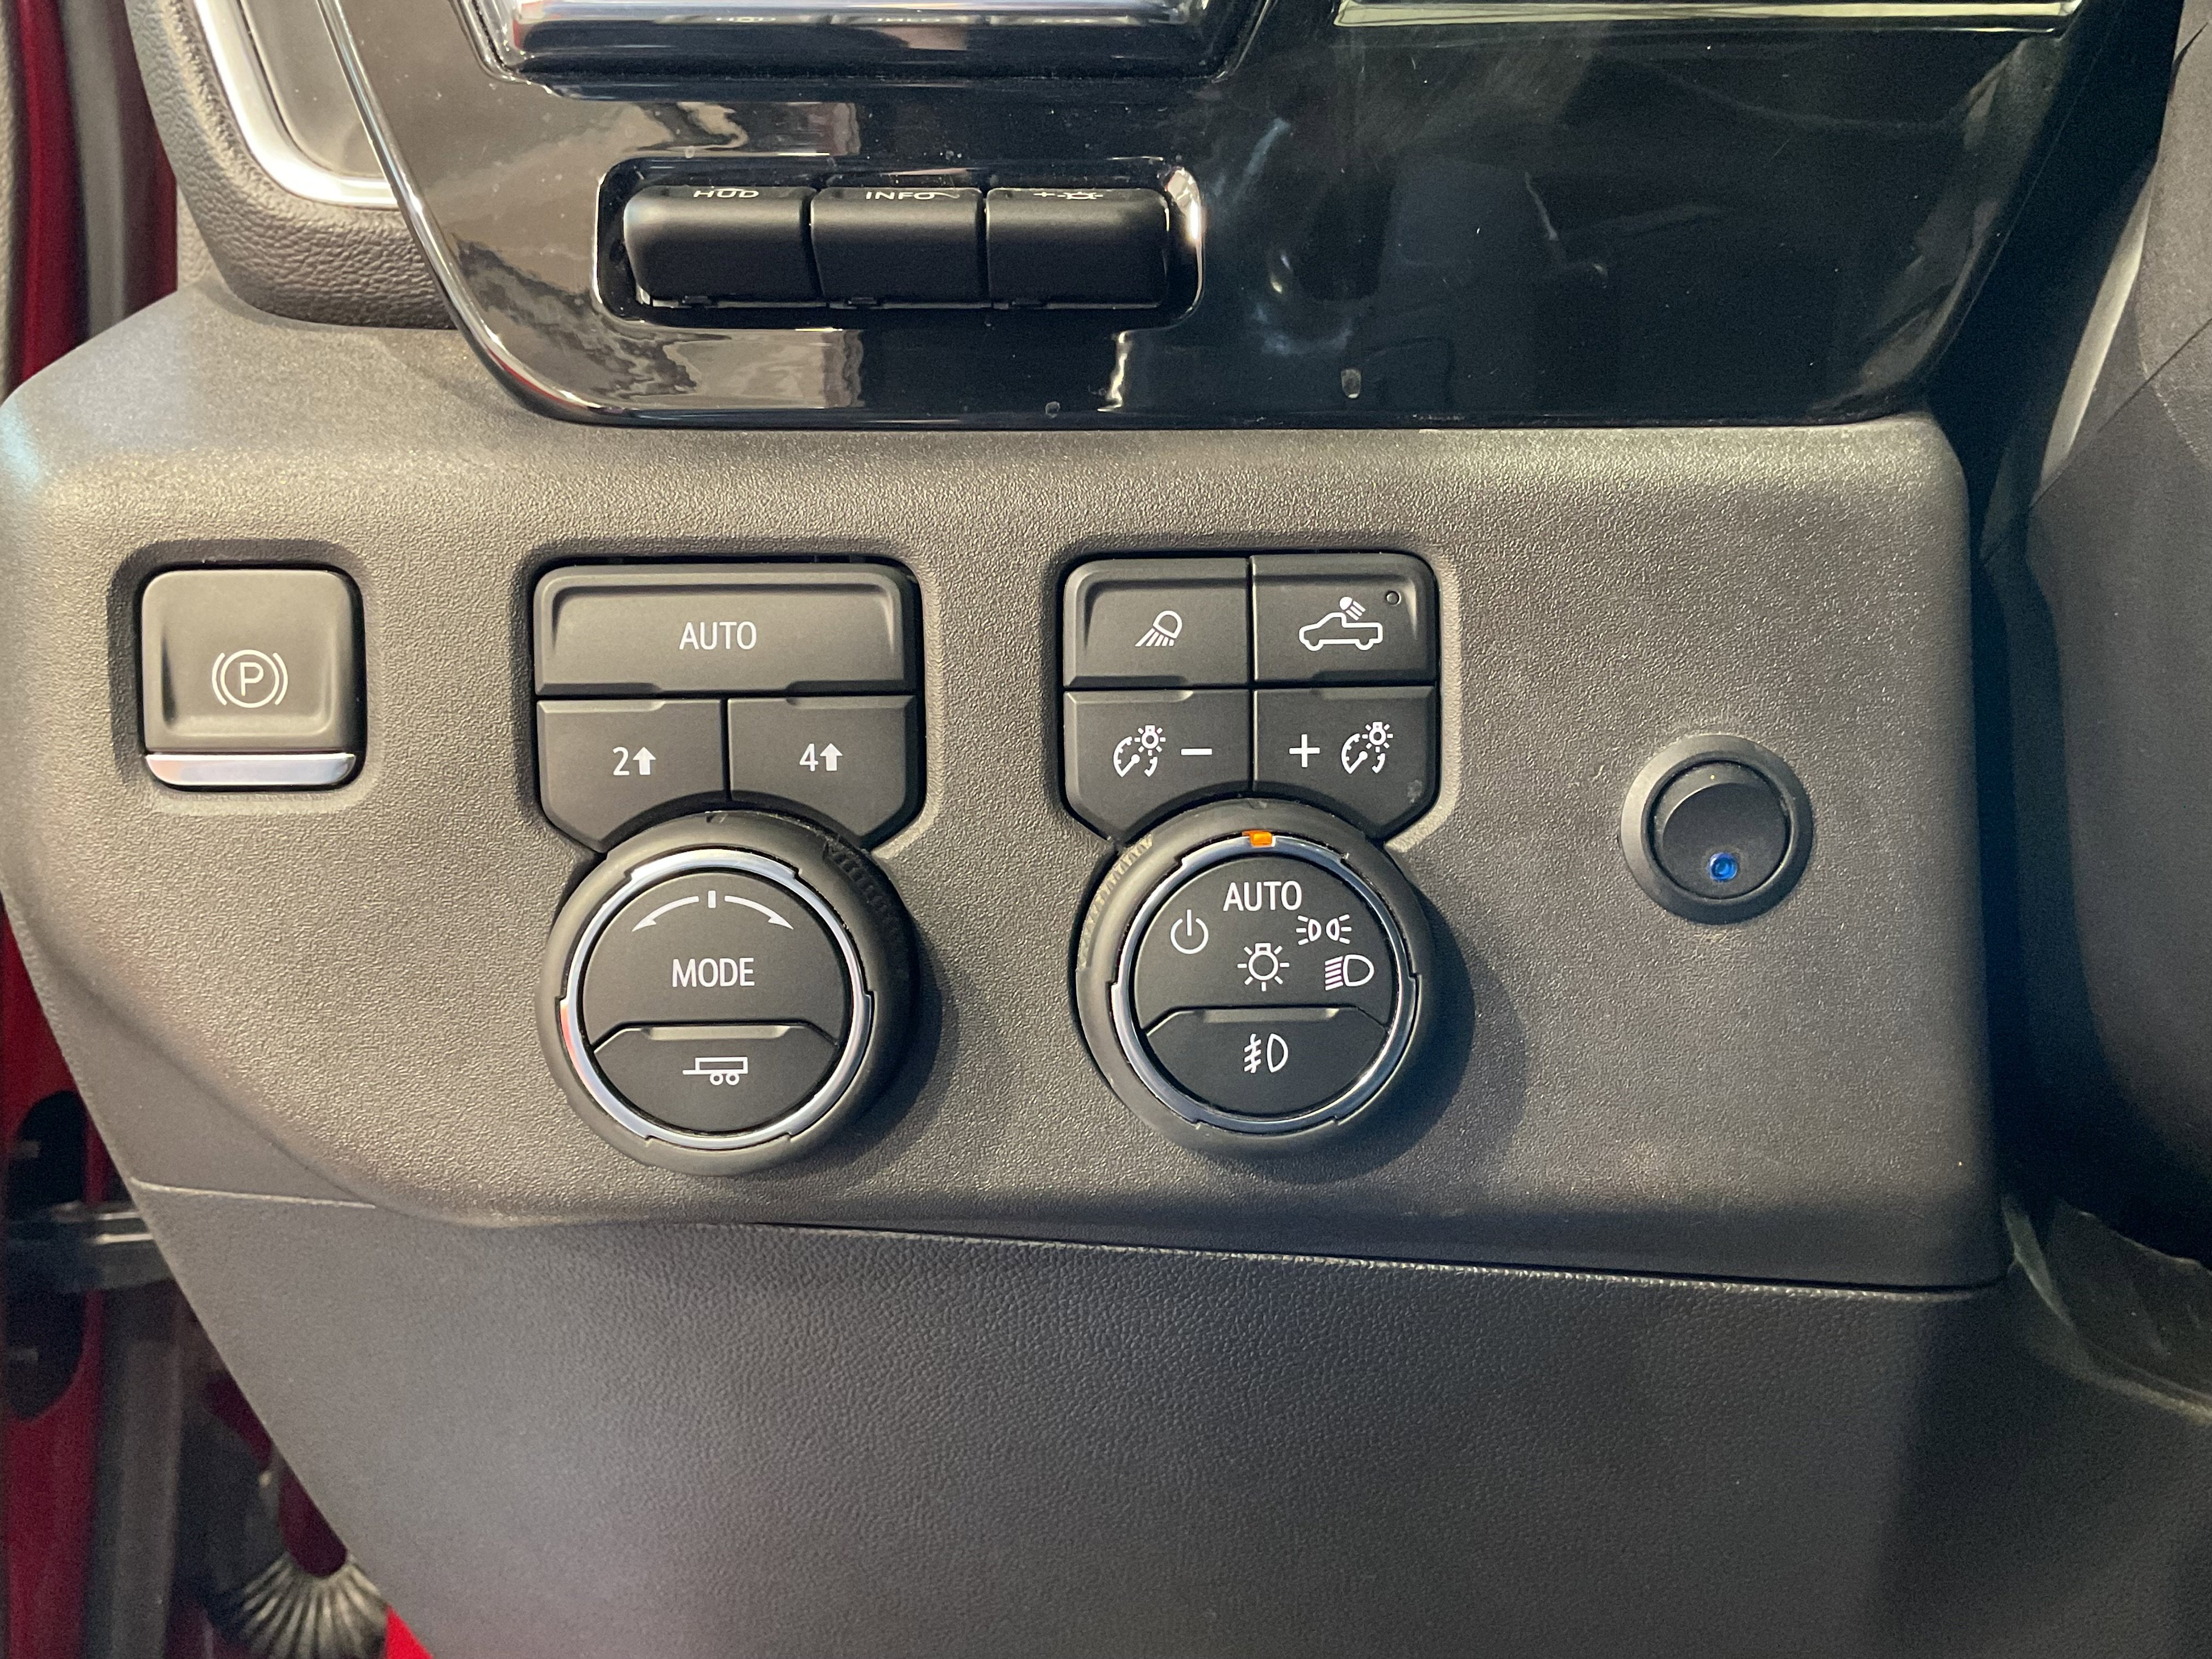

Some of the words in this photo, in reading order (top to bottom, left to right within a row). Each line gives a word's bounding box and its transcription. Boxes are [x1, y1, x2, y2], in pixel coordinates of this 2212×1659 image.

[693, 190, 759, 198] HUD
[865, 191, 935, 200] INFO
[679, 620, 757, 650] AUTO
[239, 662, 264, 697] P
[1222, 881, 1302, 911] AUTO
[672, 957, 755, 987] MODE
